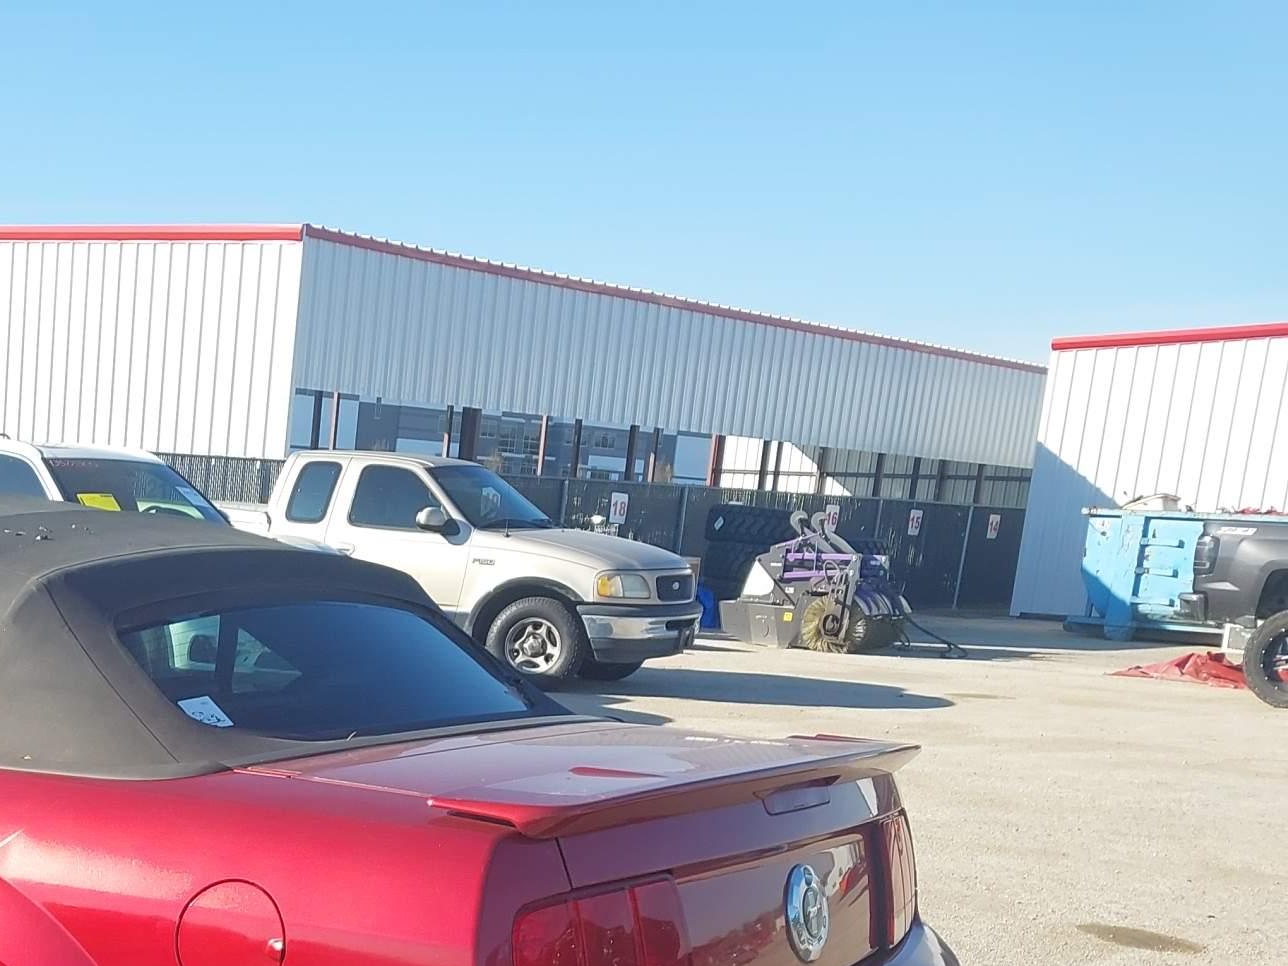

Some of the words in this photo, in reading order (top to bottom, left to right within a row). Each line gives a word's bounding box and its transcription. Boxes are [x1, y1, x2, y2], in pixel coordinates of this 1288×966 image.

[612, 500, 627, 517] 18
[825, 511, 838, 526] 16
[910, 515, 921, 529] 15
[989, 519, 999, 534] 14
